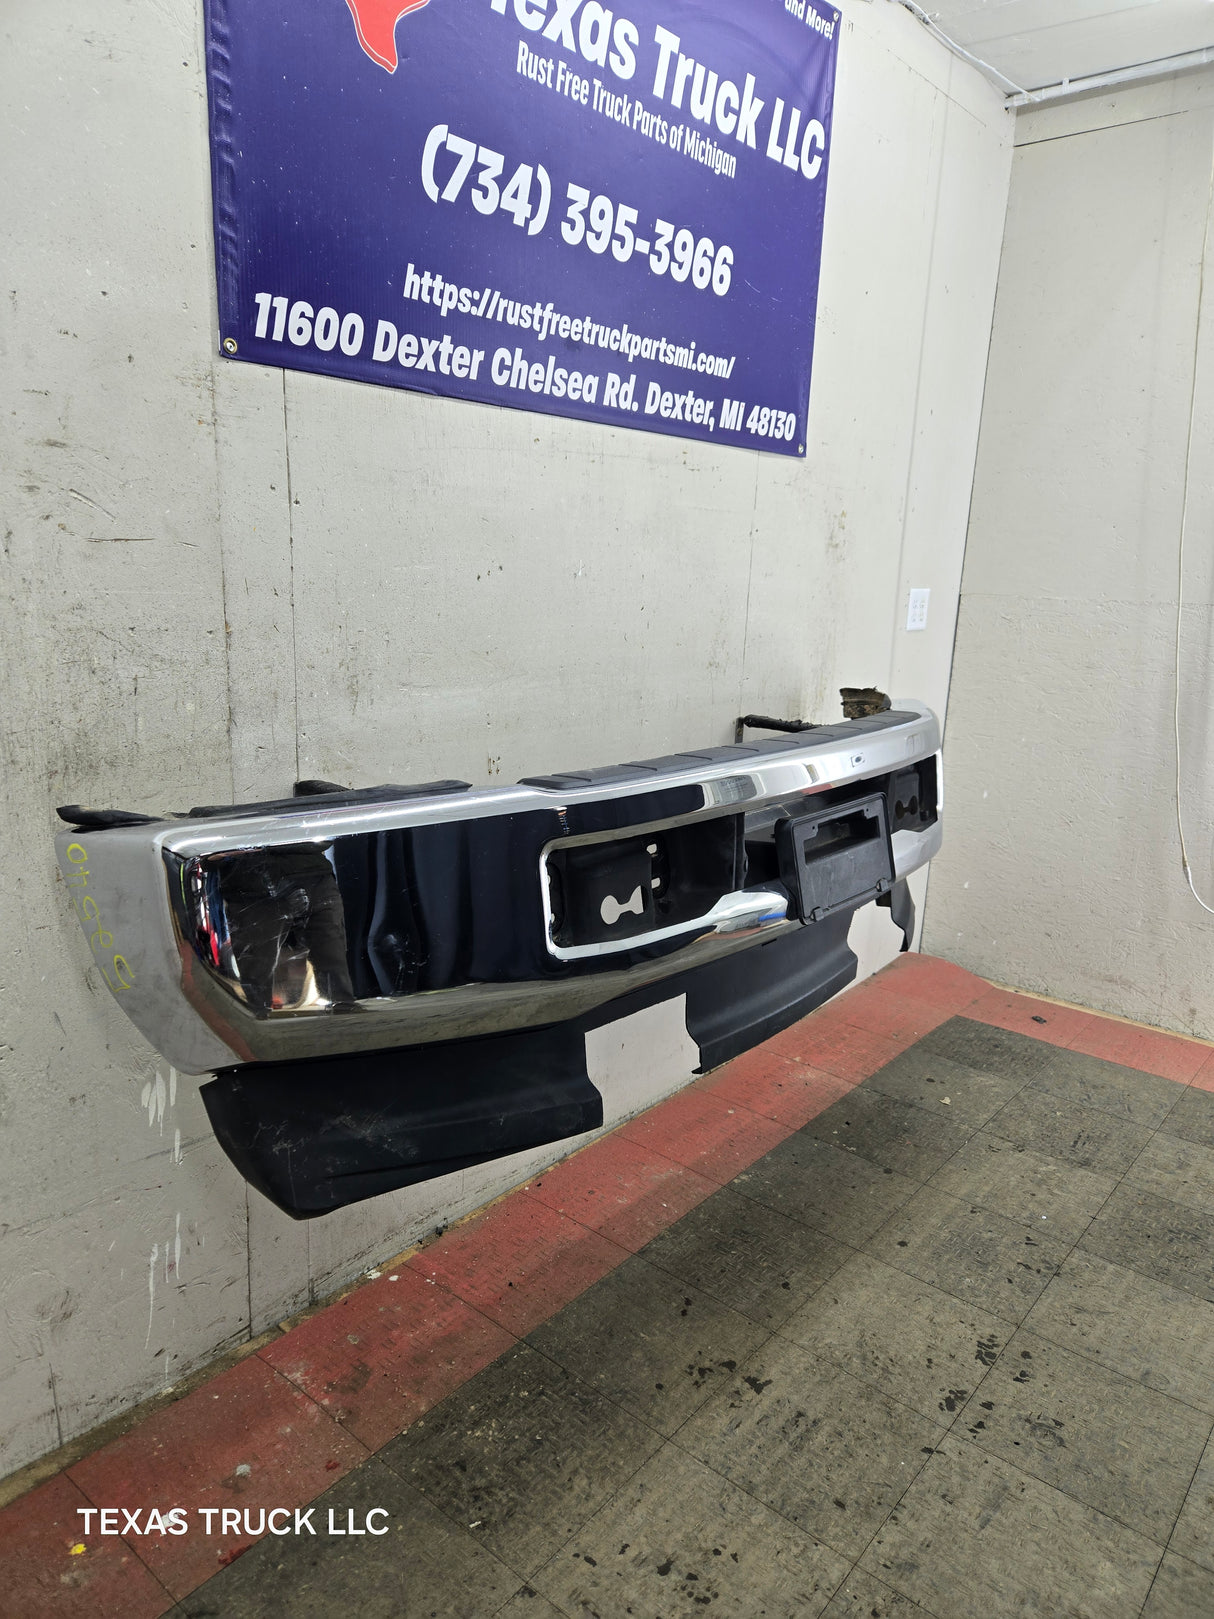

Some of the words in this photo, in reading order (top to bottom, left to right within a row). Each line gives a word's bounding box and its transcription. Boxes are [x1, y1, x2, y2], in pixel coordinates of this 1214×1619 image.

[491, 0, 639, 79] exas
[653, 24, 764, 149] Truck
[766, 97, 825, 179] LLC
[785, 0, 806, 20] and
[806, 5, 835, 40] More!
[517, 40, 554, 88] Rust
[556, 60, 589, 105] Free
[593, 78, 632, 127] Truck
[633, 100, 668, 144] Parts
[669, 124, 684, 151] of
[684, 127, 737, 179] Michigan
[421, 124, 551, 236] (734)
[561, 183, 734, 297] 395-3966
[254, 293, 364, 355] 11600
[372, 320, 484, 380] Dexter
[491, 348, 600, 403] Chelsea
[603, 372, 639, 412] Rd.
[644, 382, 714, 432] Dexter,
[719, 398, 745, 431] MI
[746, 405, 797, 441] 48130
[403, 263, 736, 379] https://rustfreetruckpartsmi.com/
